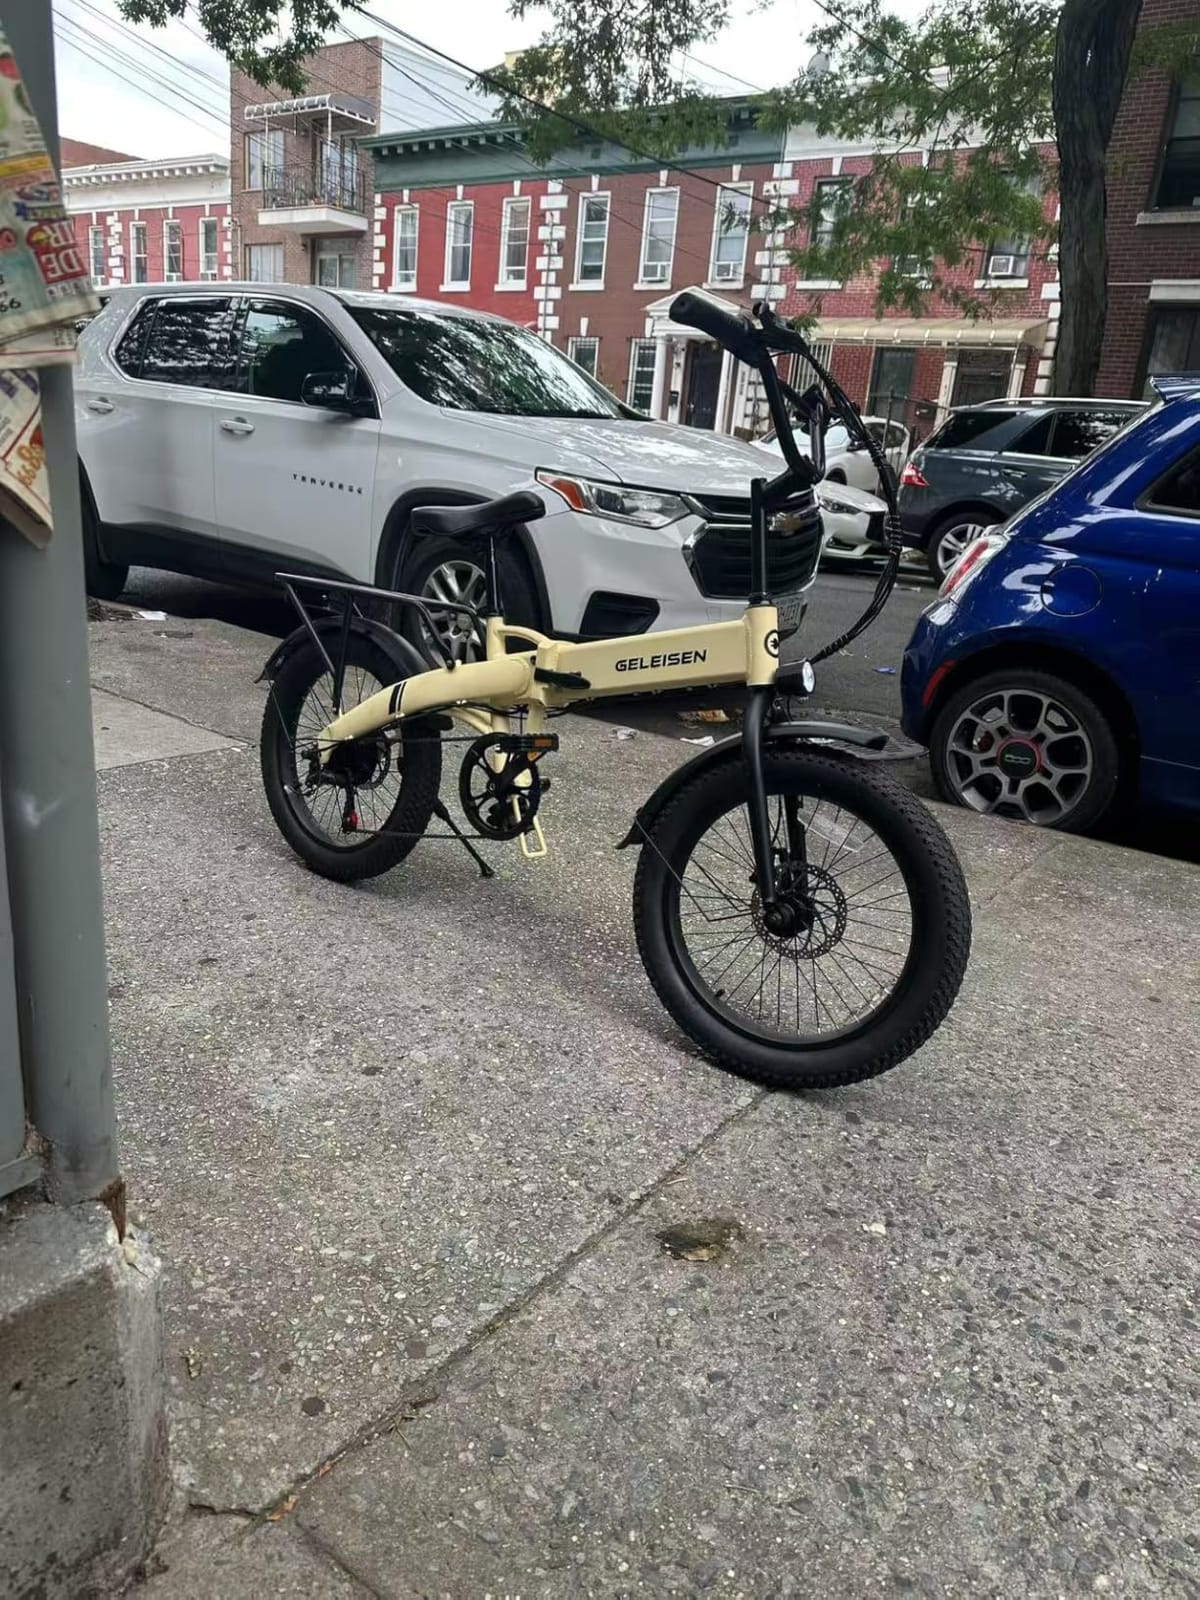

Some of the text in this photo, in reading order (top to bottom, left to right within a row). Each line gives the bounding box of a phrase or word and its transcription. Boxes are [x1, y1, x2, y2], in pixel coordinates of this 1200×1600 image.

[41, 249, 82, 278] DE
[292, 473, 363, 495] TRAVERSE
[615, 649, 707, 672] GELEISEN
